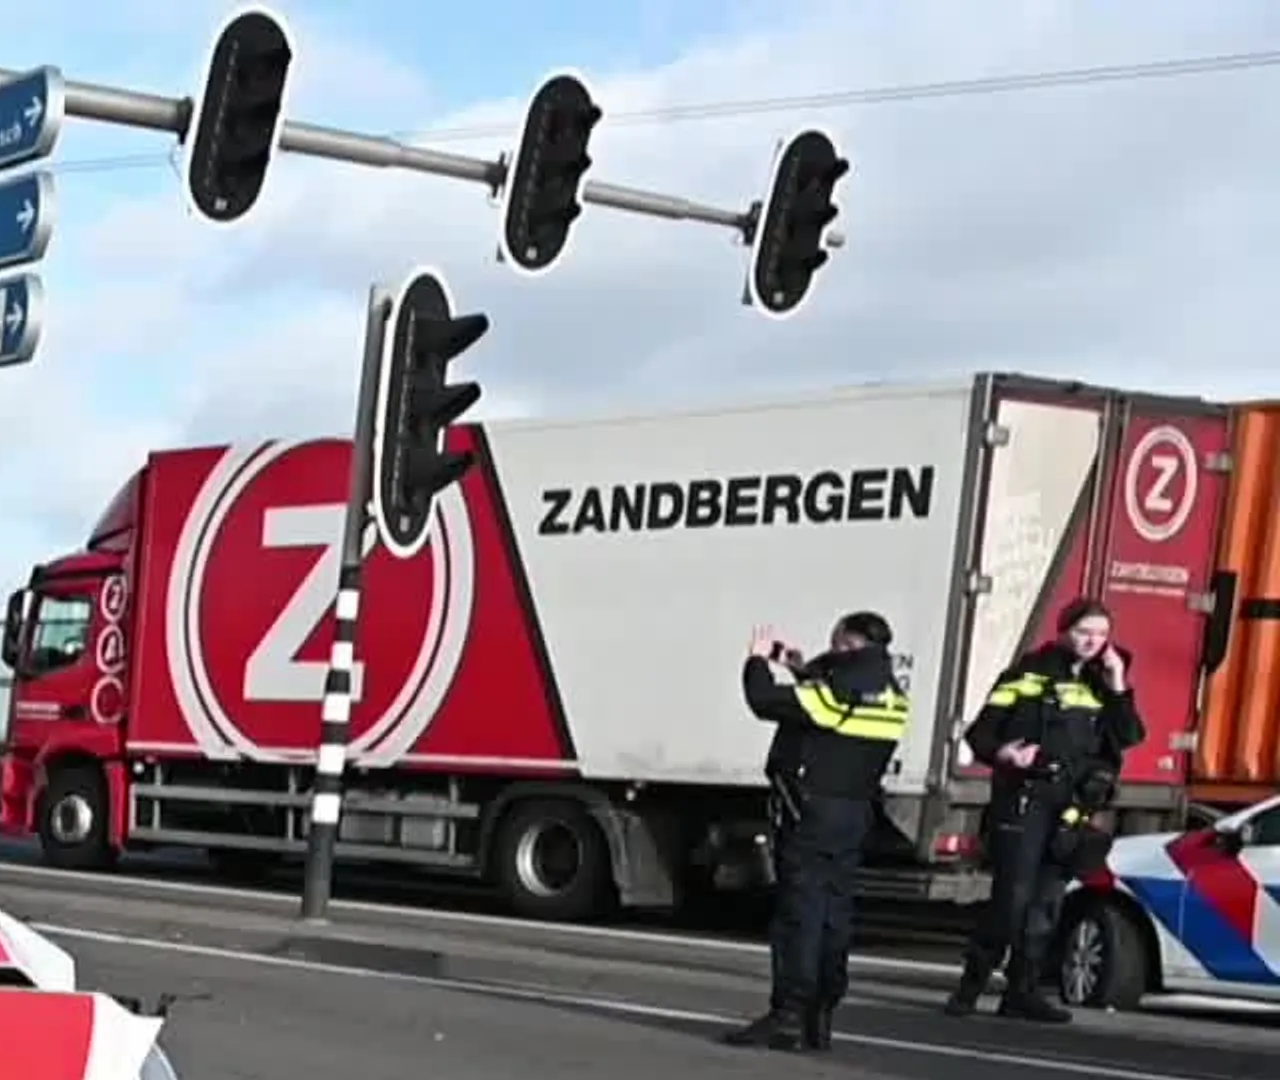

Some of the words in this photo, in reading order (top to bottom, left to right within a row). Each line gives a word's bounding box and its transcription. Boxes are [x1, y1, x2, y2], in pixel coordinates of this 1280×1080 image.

[538, 465, 935, 535] ZANDBERGEN
[1145, 454, 1179, 511] Z
[244, 503, 364, 700] Z
